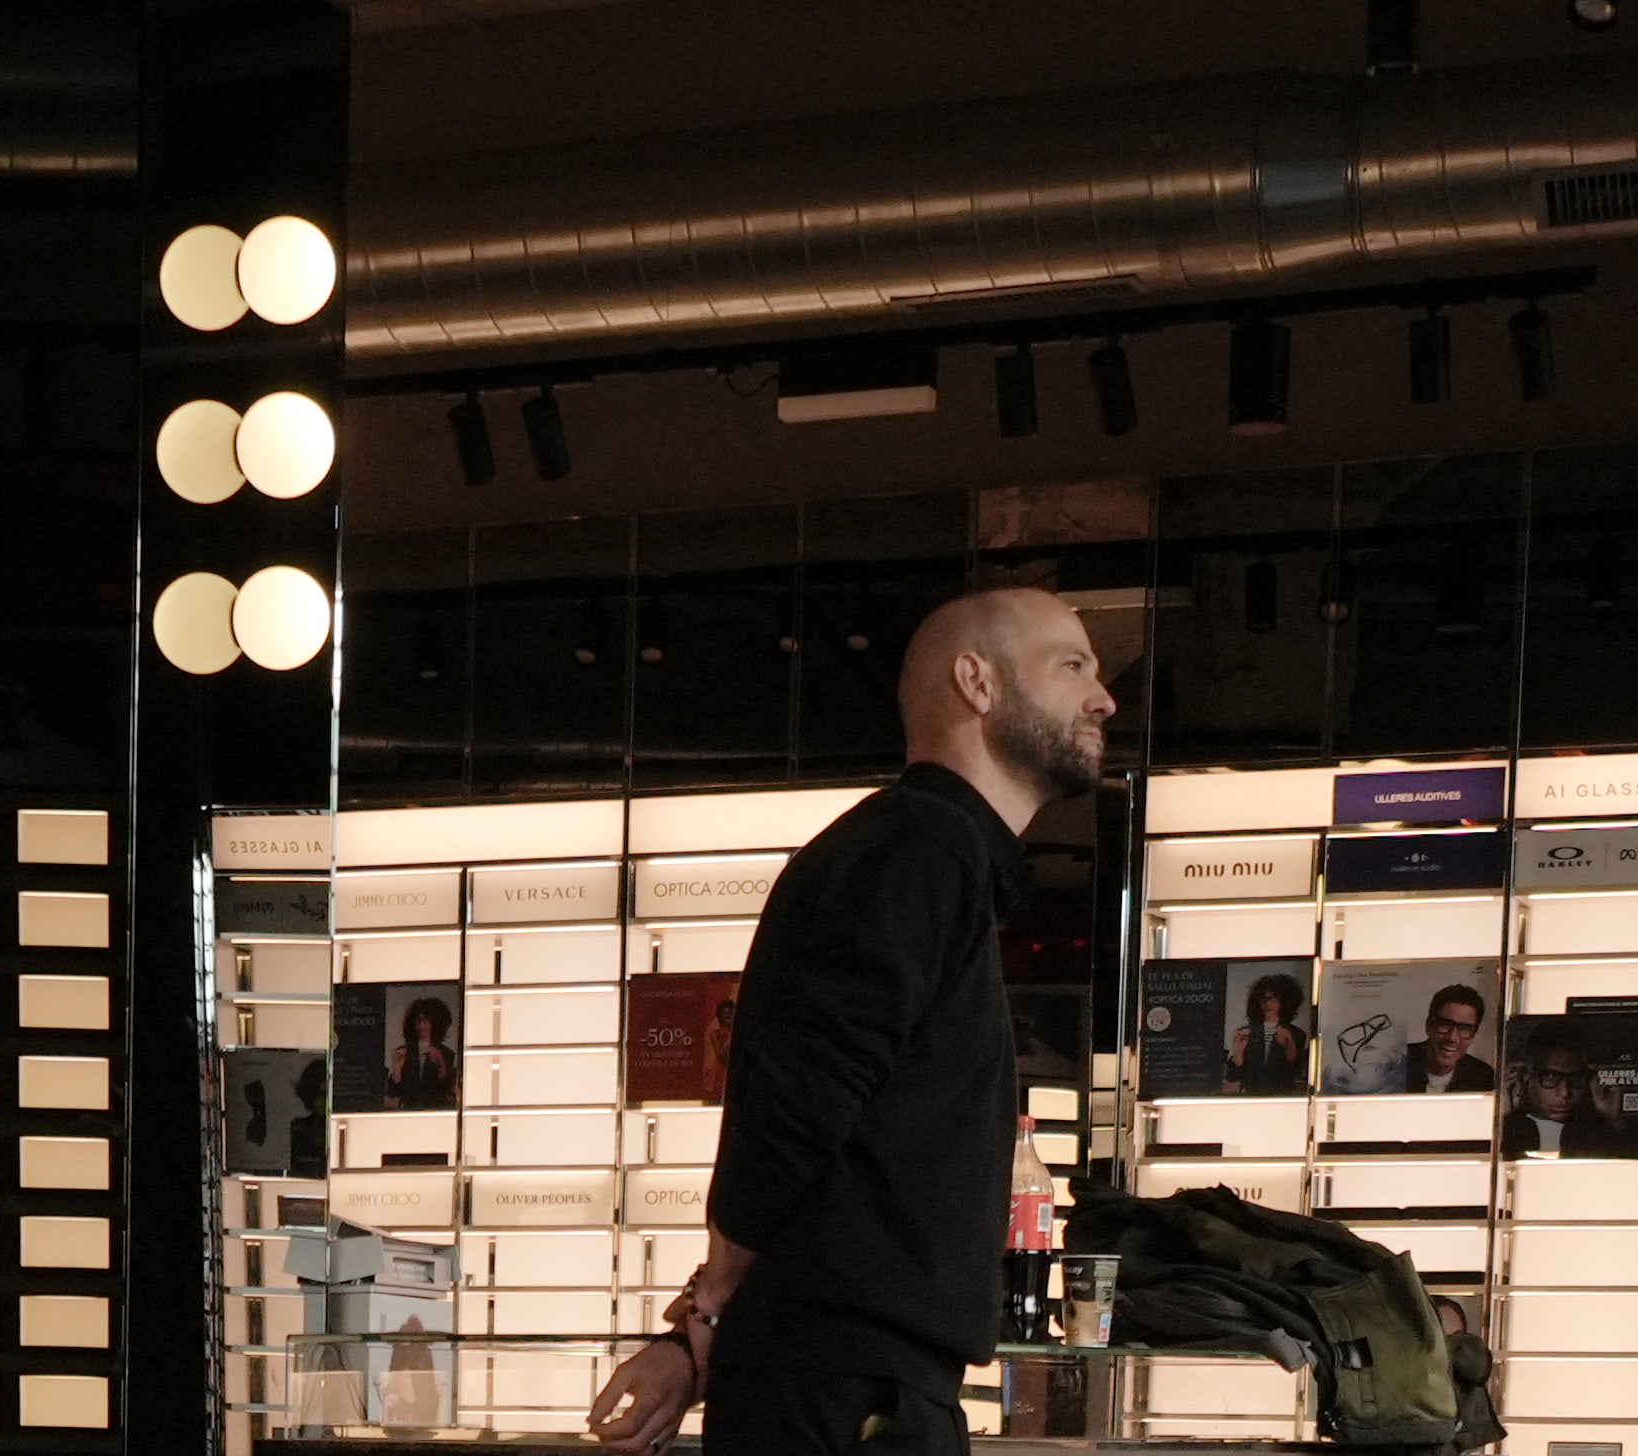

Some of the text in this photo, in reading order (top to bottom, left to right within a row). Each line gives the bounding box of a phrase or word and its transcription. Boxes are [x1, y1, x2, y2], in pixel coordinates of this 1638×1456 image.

[1374, 790, 1461, 804] ULLERES AUDITIVES
[1544, 784, 1565, 799] AI
[504, 886, 587, 901] VERSACE
[654, 879, 769, 898] OPTICA 2000
[351, 893, 427, 908] JIMMY CHOO
[640, 1028, 692, 1047] -50%
[345, 1192, 421, 1206] JIMMY CHOO
[495, 1193, 592, 1205] OLIVER PEOPLES
[644, 1190, 702, 1206] OPTICA
